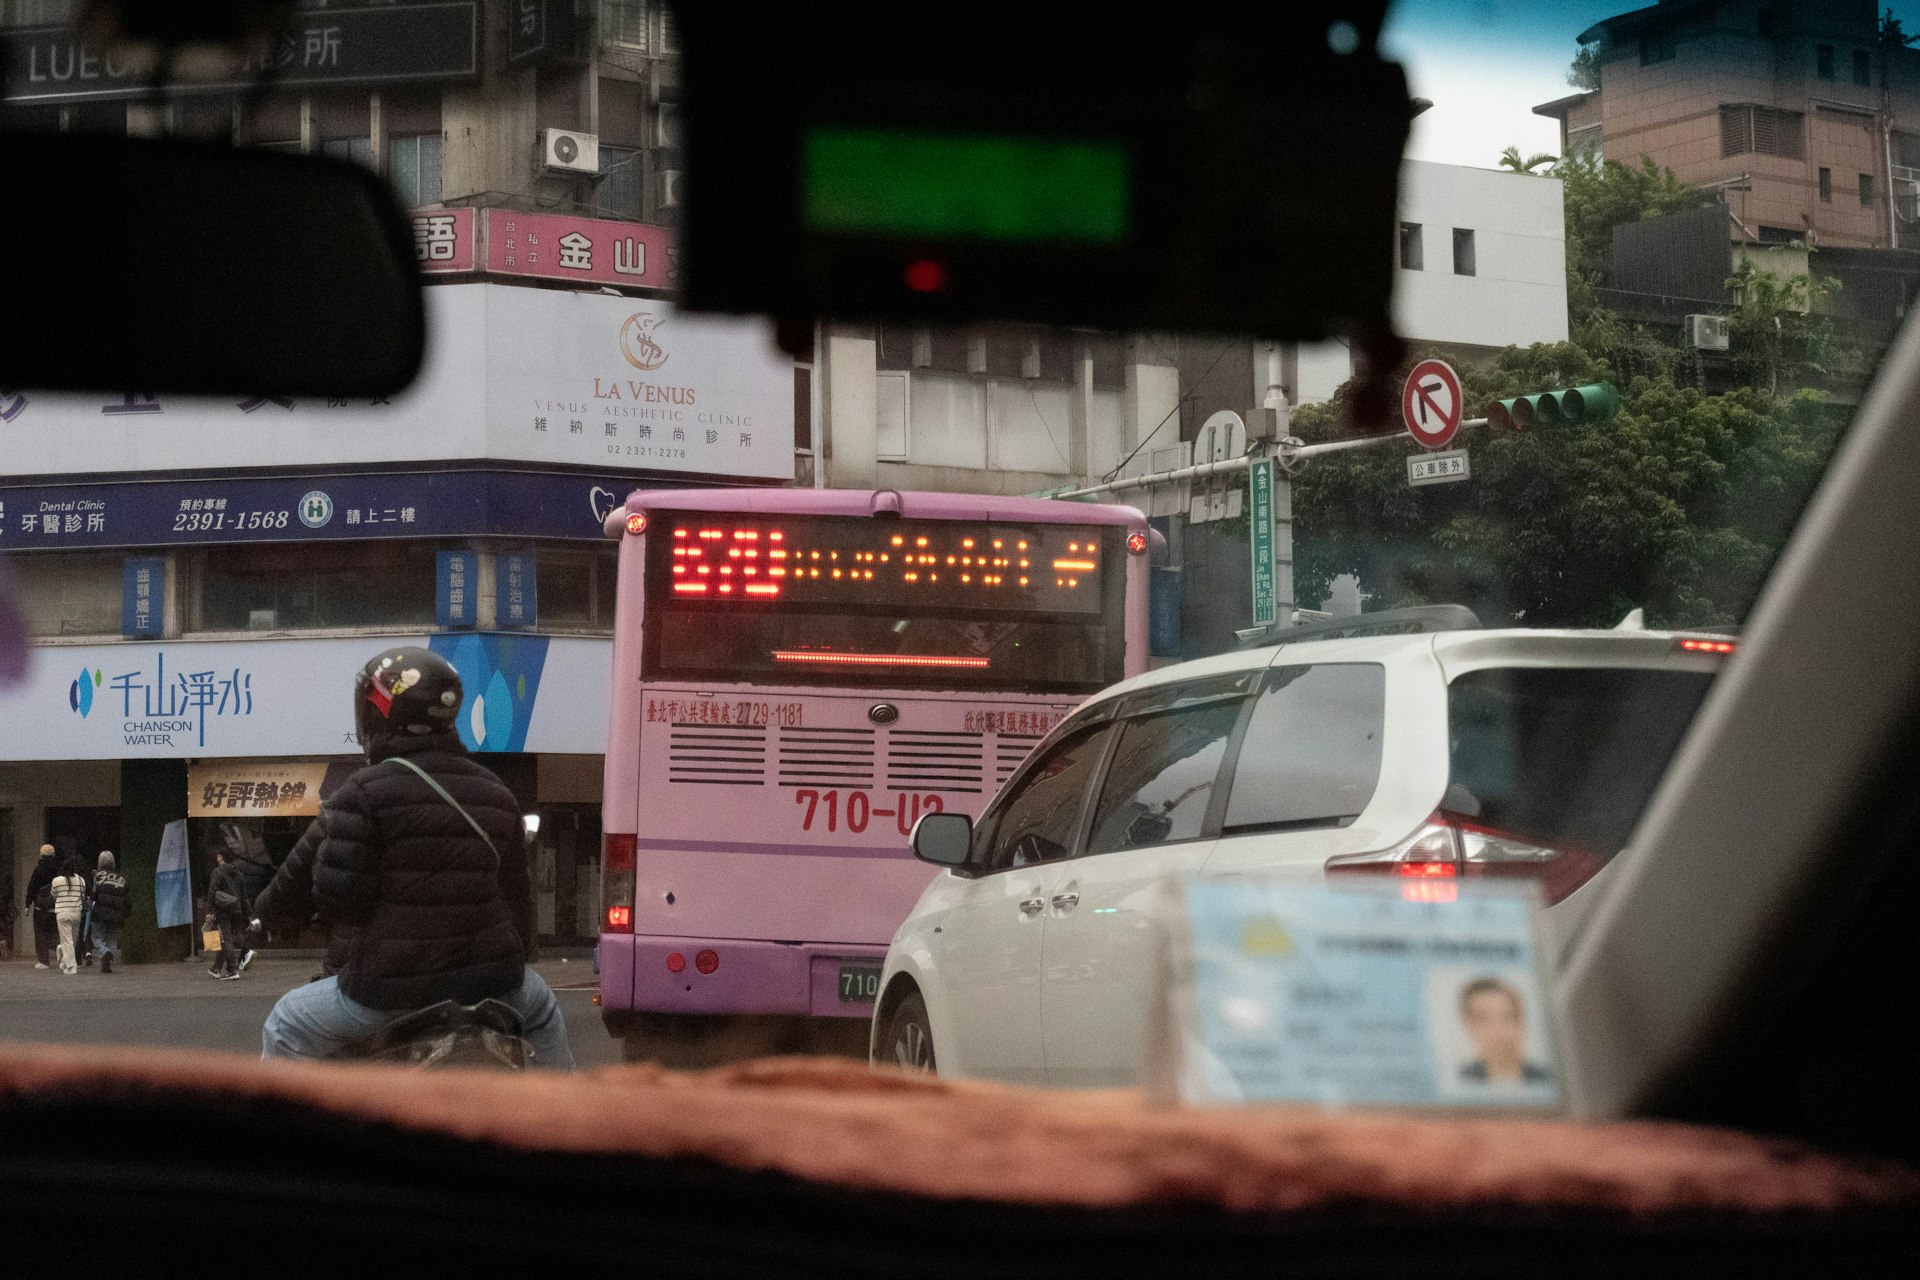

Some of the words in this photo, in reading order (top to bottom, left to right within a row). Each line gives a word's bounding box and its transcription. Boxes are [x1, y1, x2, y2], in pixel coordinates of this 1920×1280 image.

[413, 216, 455, 260] 語
[505, 221, 515, 267] 台北市
[528, 233, 538, 263] 私立
[594, 378, 621, 400] LA
[628, 381, 696, 405] VENUS
[535, 400, 587, 414] VENUS
[603, 406, 683, 421] AESTHETIC
[698, 413, 752, 427] CLINIC
[534, 416, 752, 447] 維納斯時尚診所
[607, 445, 620, 454] 02
[626, 446, 686, 458] 2321-2278
[1415, 460, 1460, 477] 公車除外
[40, 501, 74, 512] Dental
[77, 500, 105, 511] Clinic
[179, 498, 227, 511] 預約專線
[21, 513, 105, 534] 牙醫診所
[173, 511, 289, 532] 2391-1568
[346, 507, 416, 525] 請上二樓
[109, 652, 252, 747] 千山淨水
[124, 721, 192, 732] CHANSON
[124, 734, 174, 747] WATER
